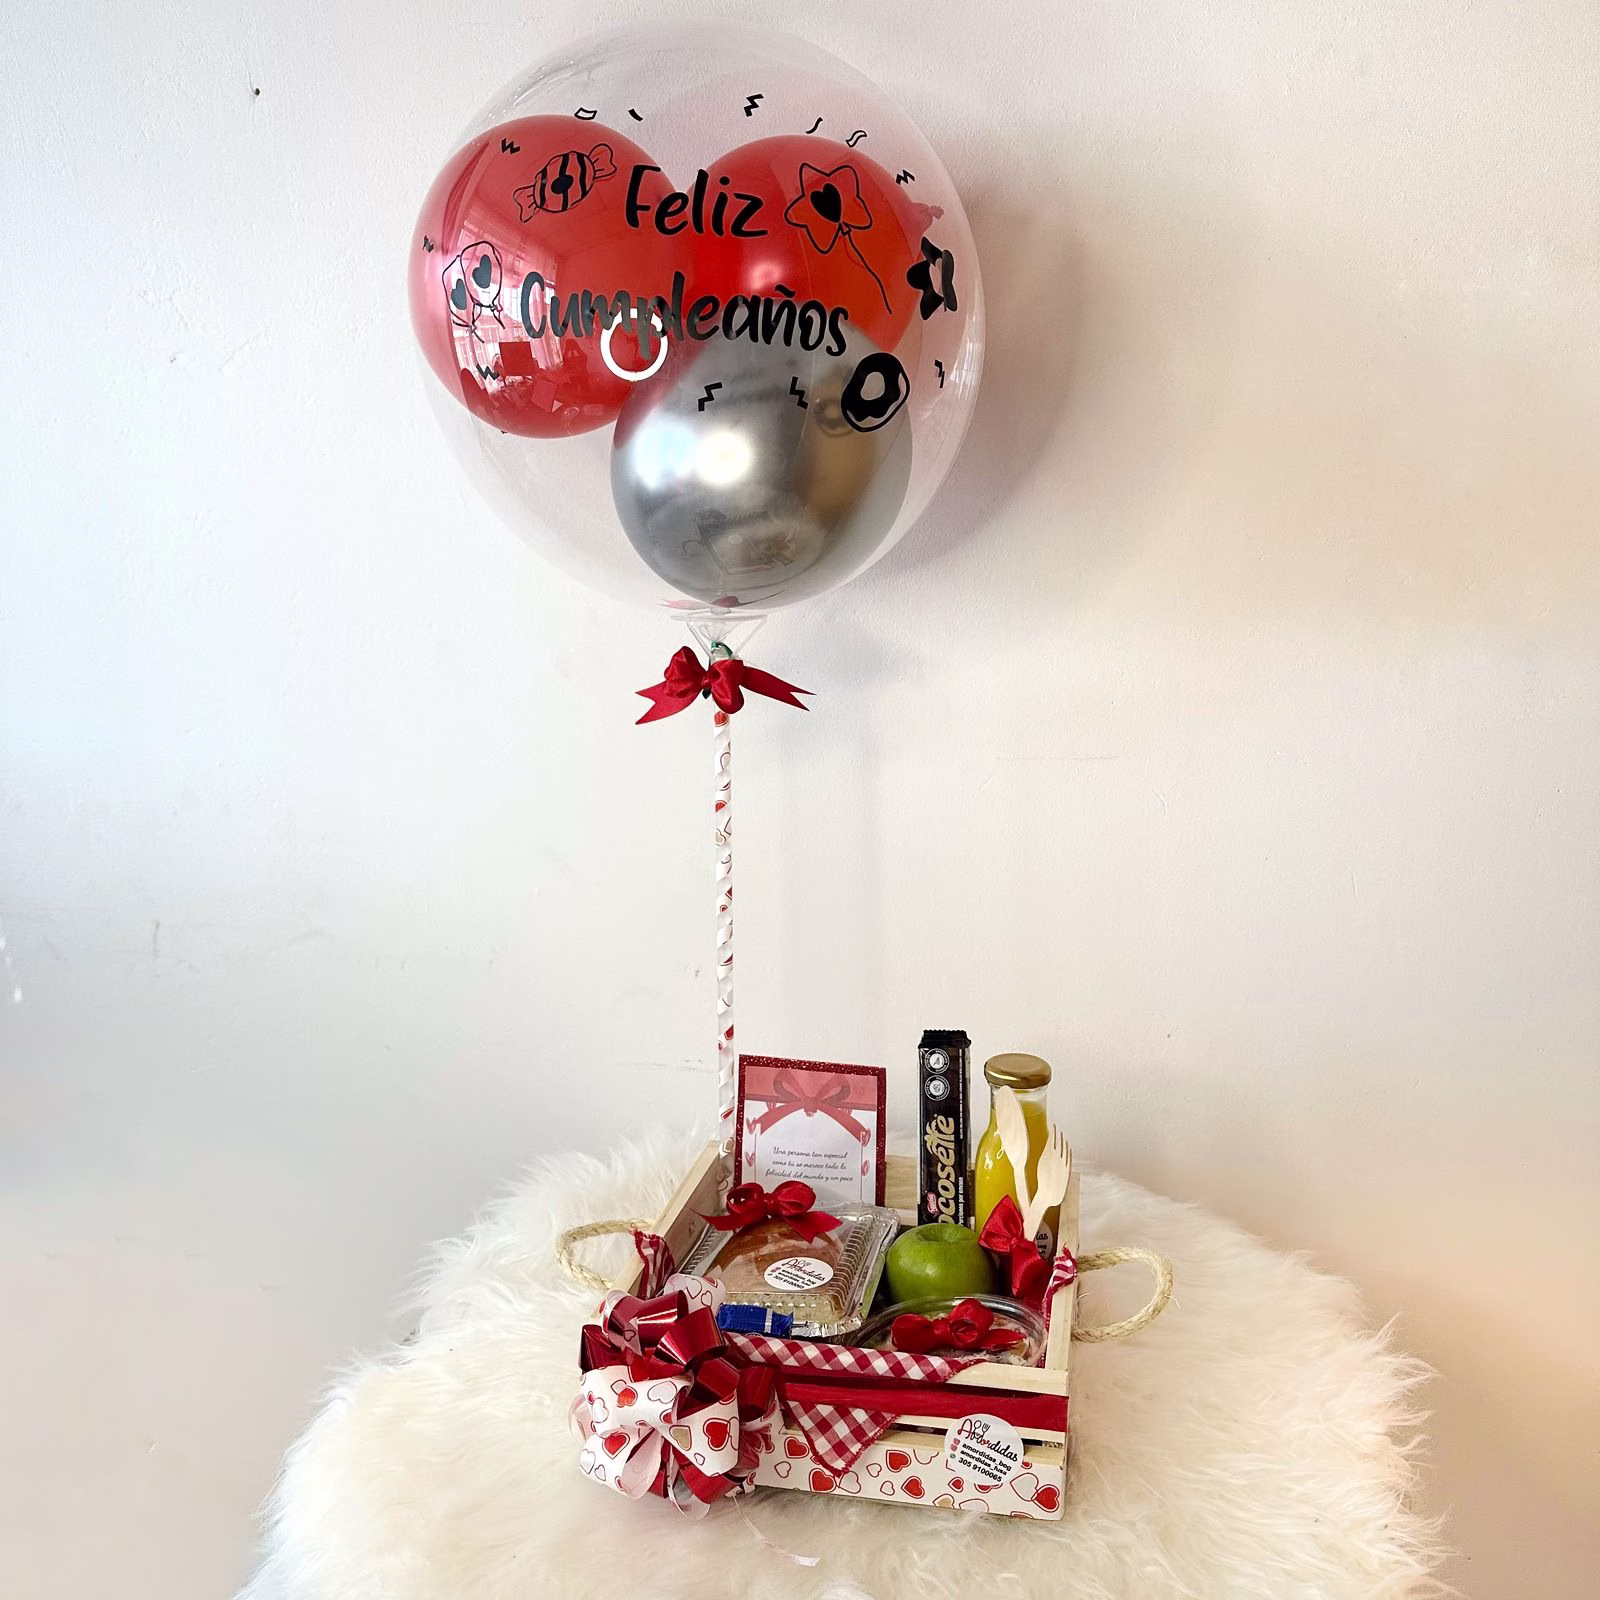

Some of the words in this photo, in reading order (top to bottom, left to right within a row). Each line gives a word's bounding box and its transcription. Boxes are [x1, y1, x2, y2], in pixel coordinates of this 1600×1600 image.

[625, 165, 769, 238] Feliz
[521, 272, 849, 358] Cumpleaños
[765, 1168, 792, 1177] felicidad
[924, 1115, 956, 1224] ocosette
[958, 1457, 972, 1468] 305
[972, 1464, 1002, 1482] 9100065
